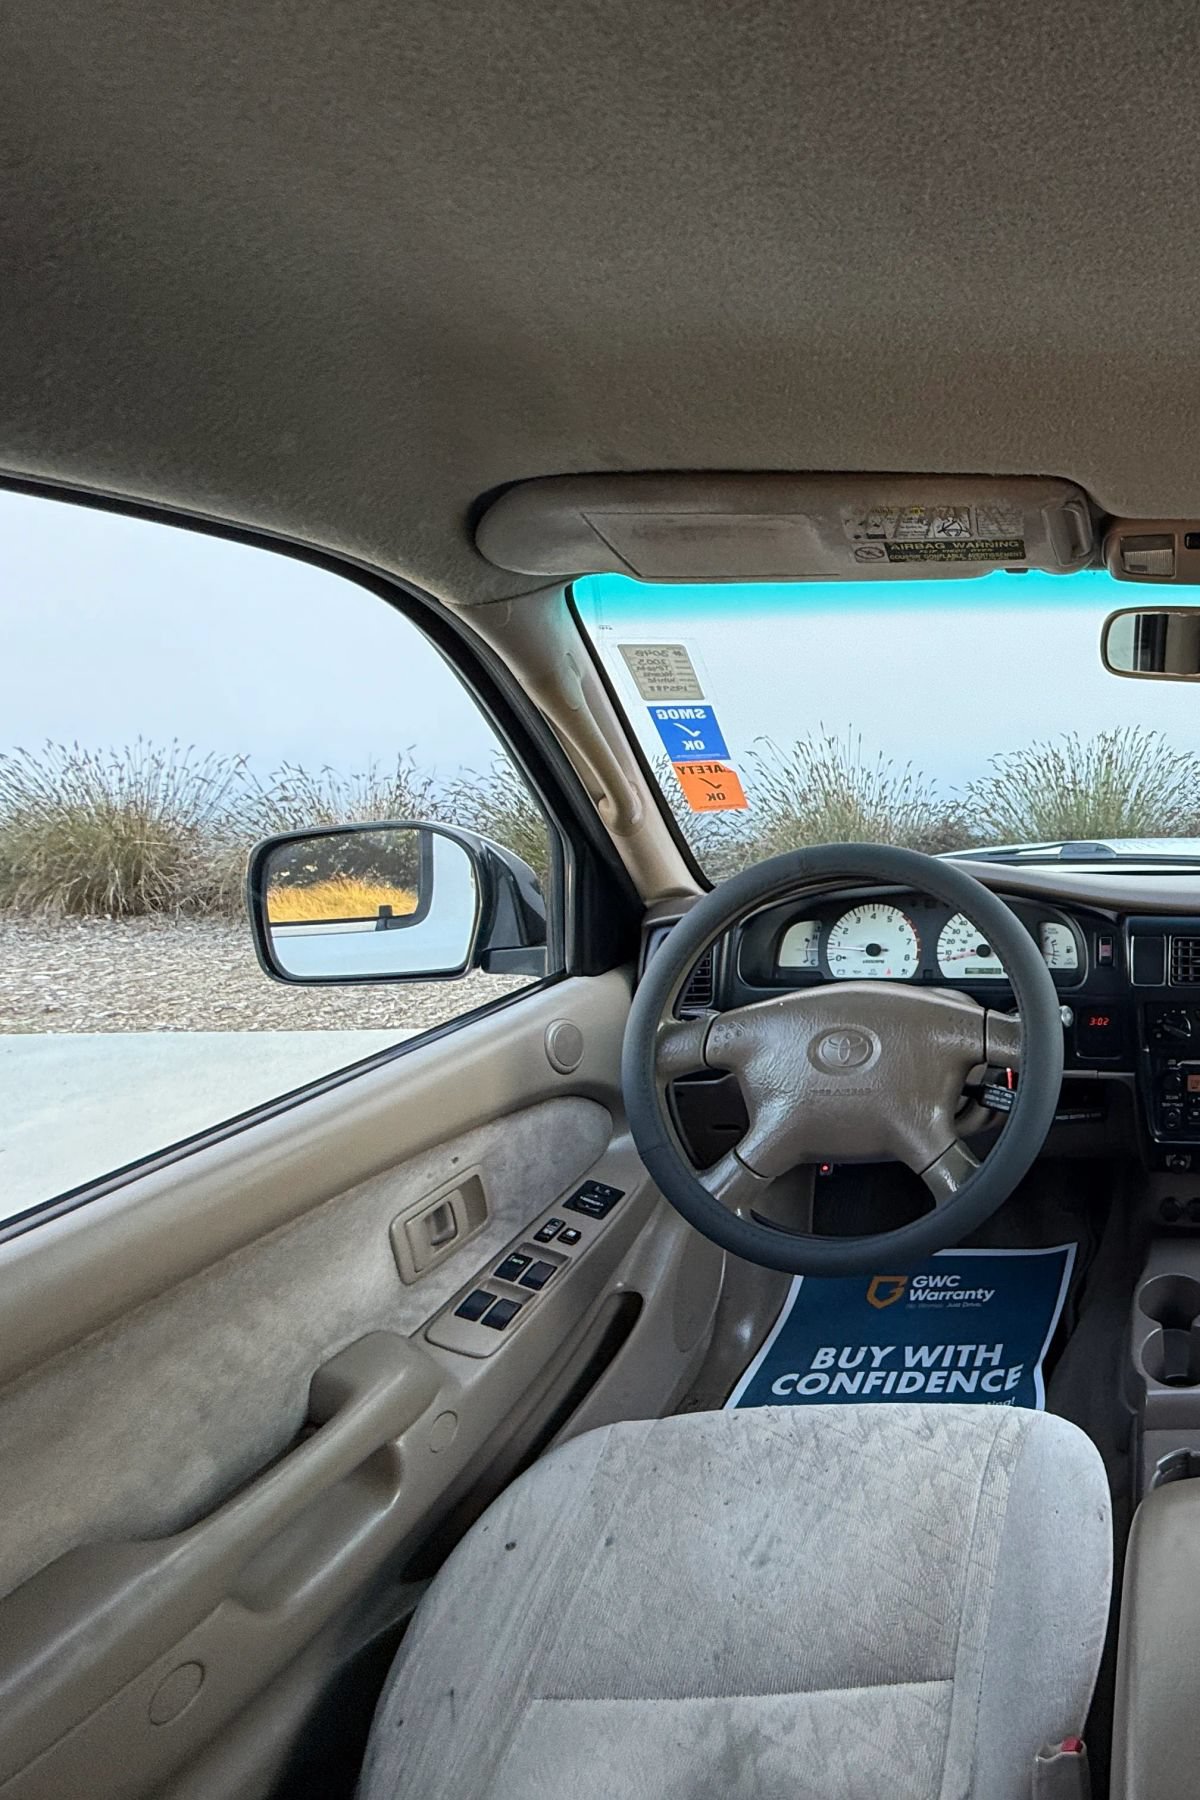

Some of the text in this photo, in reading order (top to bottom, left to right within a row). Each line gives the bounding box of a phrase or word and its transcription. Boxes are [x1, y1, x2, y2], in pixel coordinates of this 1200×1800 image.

[891, 542, 945, 550] AIRBAG
[870, 912, 877, 920] 4
[1089, 1017, 1110, 1026] 3:02
[912, 1275, 961, 1288] GWC
[909, 1288, 995, 1302] Warranty
[810, 1343, 1004, 1370] BUY WITH
[771, 1362, 1024, 1396] CONFIDENCE
